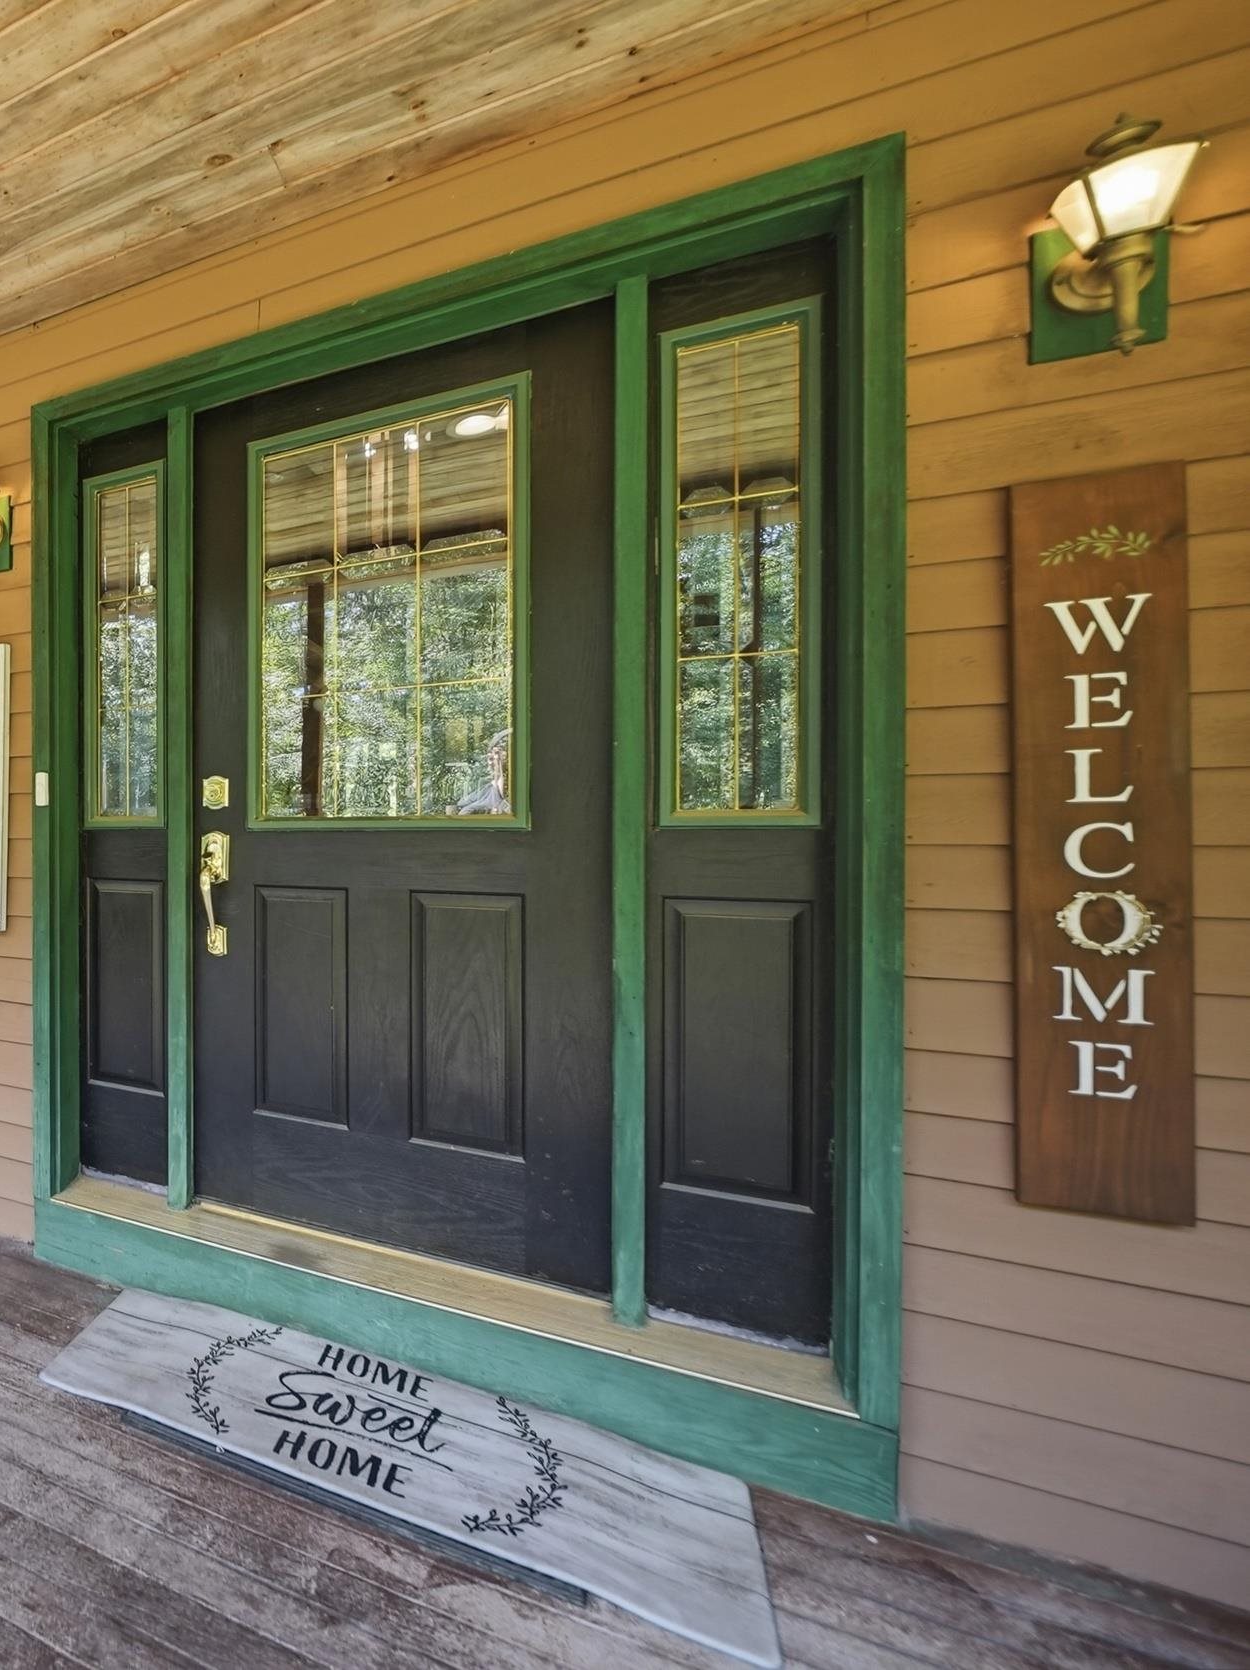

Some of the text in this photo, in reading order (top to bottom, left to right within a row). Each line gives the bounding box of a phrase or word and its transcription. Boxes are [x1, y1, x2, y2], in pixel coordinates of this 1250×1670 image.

[1044, 593, 1159, 1099] WELCOME
[317, 1344, 434, 1402] HOME
[265, 1370, 446, 1453] Sweet
[273, 1430, 413, 1498] HOME
